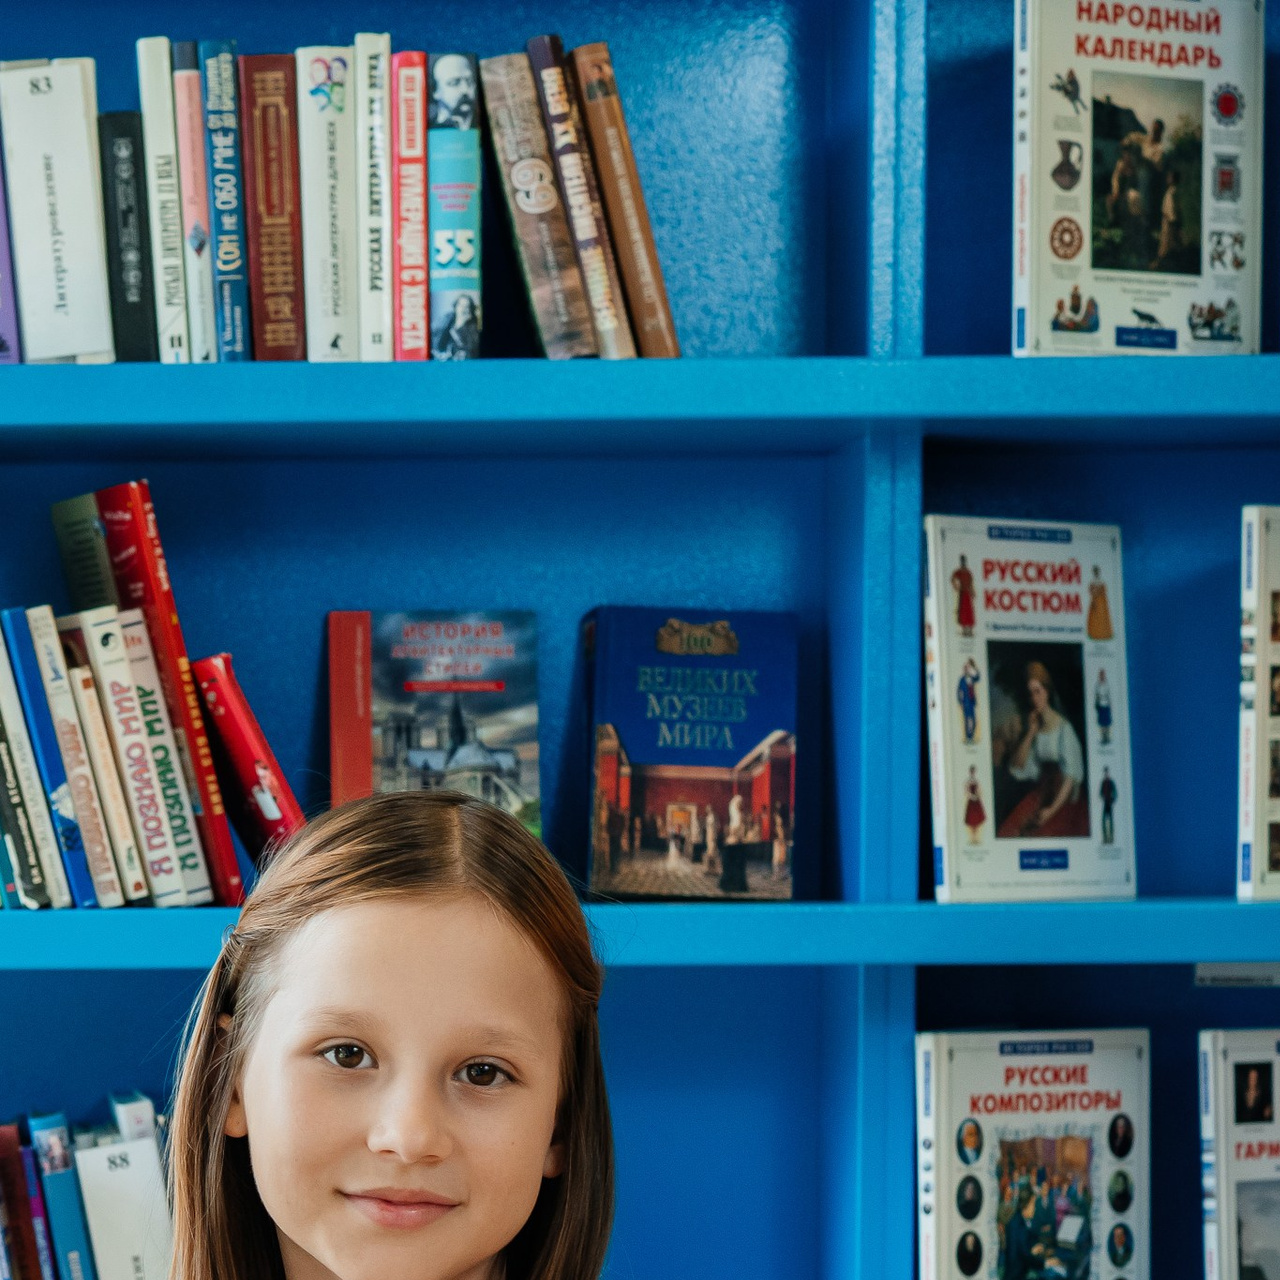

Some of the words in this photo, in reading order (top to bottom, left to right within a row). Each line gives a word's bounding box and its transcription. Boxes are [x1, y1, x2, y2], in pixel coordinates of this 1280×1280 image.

[1076, 0, 1223, 35] НАРОДНЫЙ
[1075, 36, 1223, 70] КАЛЕНДАРЬ
[212, 130, 234, 169] МНЕ
[214, 172, 236, 209] ОБО
[510, 157, 559, 216] 69
[216, 233, 241, 269] СОН
[368, 226, 383, 291] РУССКАЯ
[434, 228, 475, 266] 55
[401, 284, 424, 349] ХВОСТА
[981, 557, 1082, 586] РУССКИЙ
[983, 588, 1083, 614] КОСТЮМ
[402, 621, 503, 641] ИСТОРИЯ
[638, 664, 760, 696] ВЕЛИКИХ
[106, 676, 142, 738] МИР
[132, 679, 168, 740] МИР
[646, 692, 749, 724] МУЗЕЕВ
[656, 720, 736, 752] МИРА
[120, 738, 170, 853] ПОЗНАЮ
[145, 740, 196, 849] ПОЗНАЮ
[148, 853, 175, 878] Я
[175, 848, 201, 874] Я
[1003, 1064, 1090, 1088] РУССКИЕ
[969, 1090, 1122, 1116] КОМПОЗИТОРЫ
[106, 1152, 131, 1170] 88
